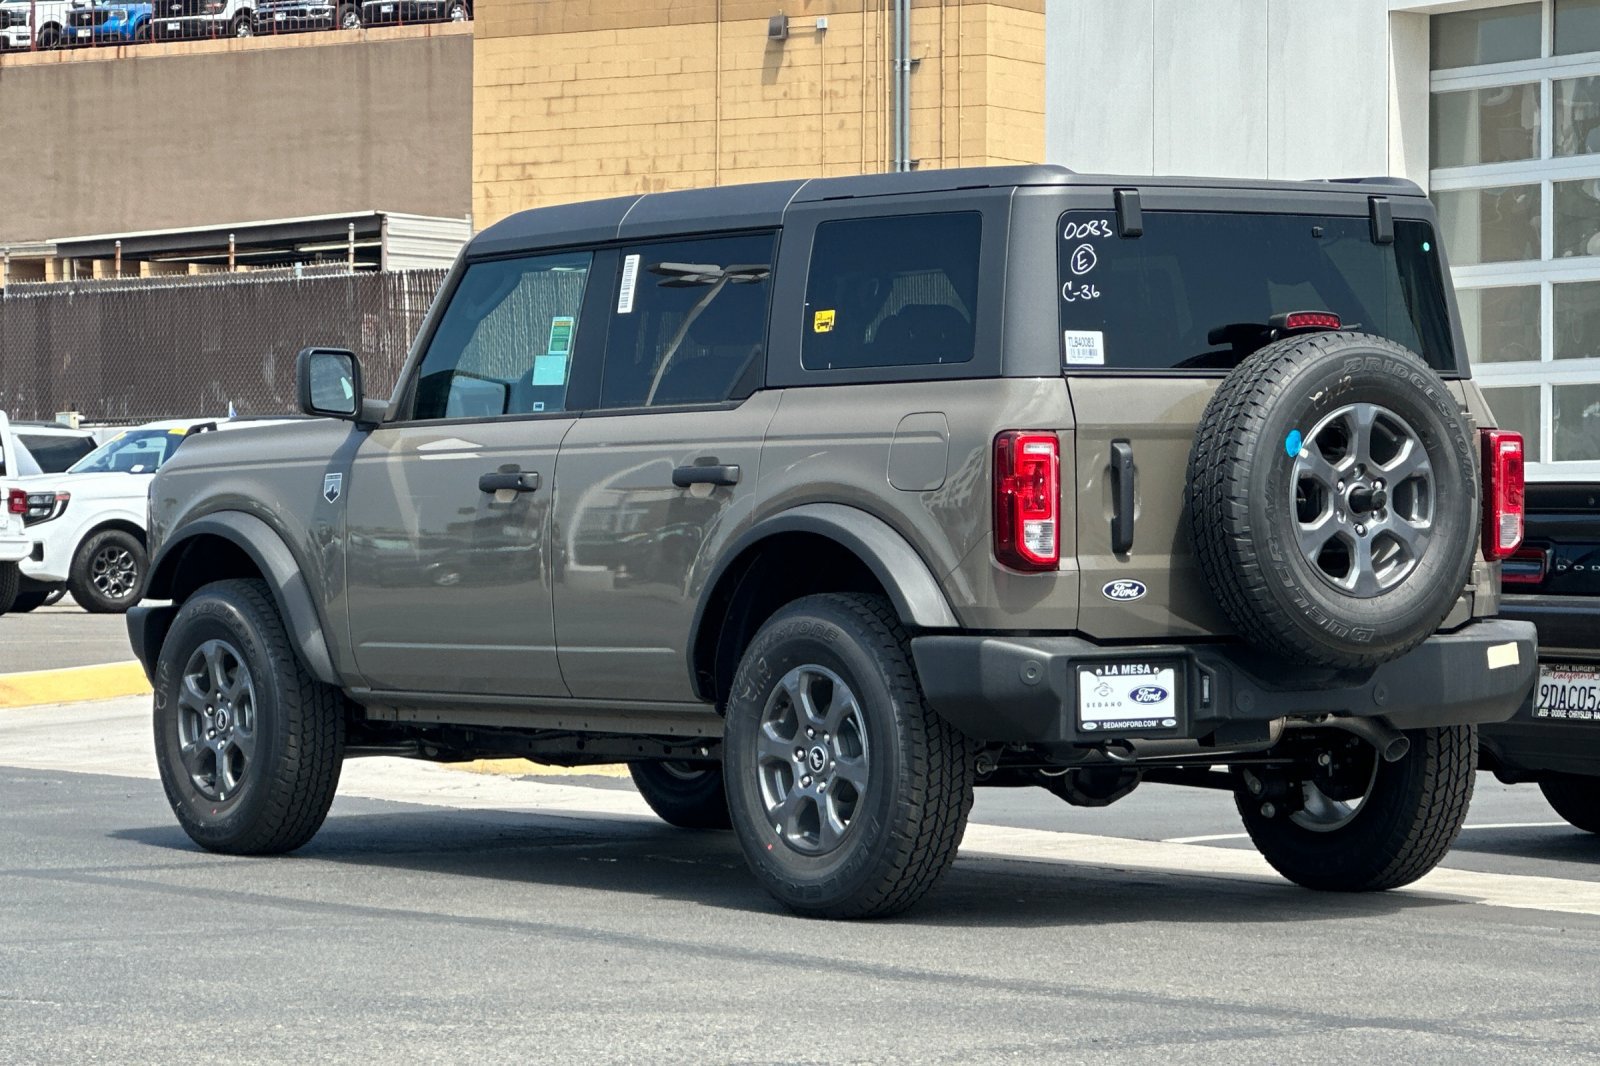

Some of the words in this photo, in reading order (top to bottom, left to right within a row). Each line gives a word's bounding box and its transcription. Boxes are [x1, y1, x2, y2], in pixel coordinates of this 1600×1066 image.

[1064, 219, 1112, 239] 0083
[1062, 281, 1100, 302] C-36
[1111, 583, 1139, 597] Ford
[1104, 665, 1118, 675] LA
[1121, 664, 1151, 674] MESA
[1135, 687, 1161, 702] Ford
[1103, 721, 1158, 729] SEDANOFORD.COM
